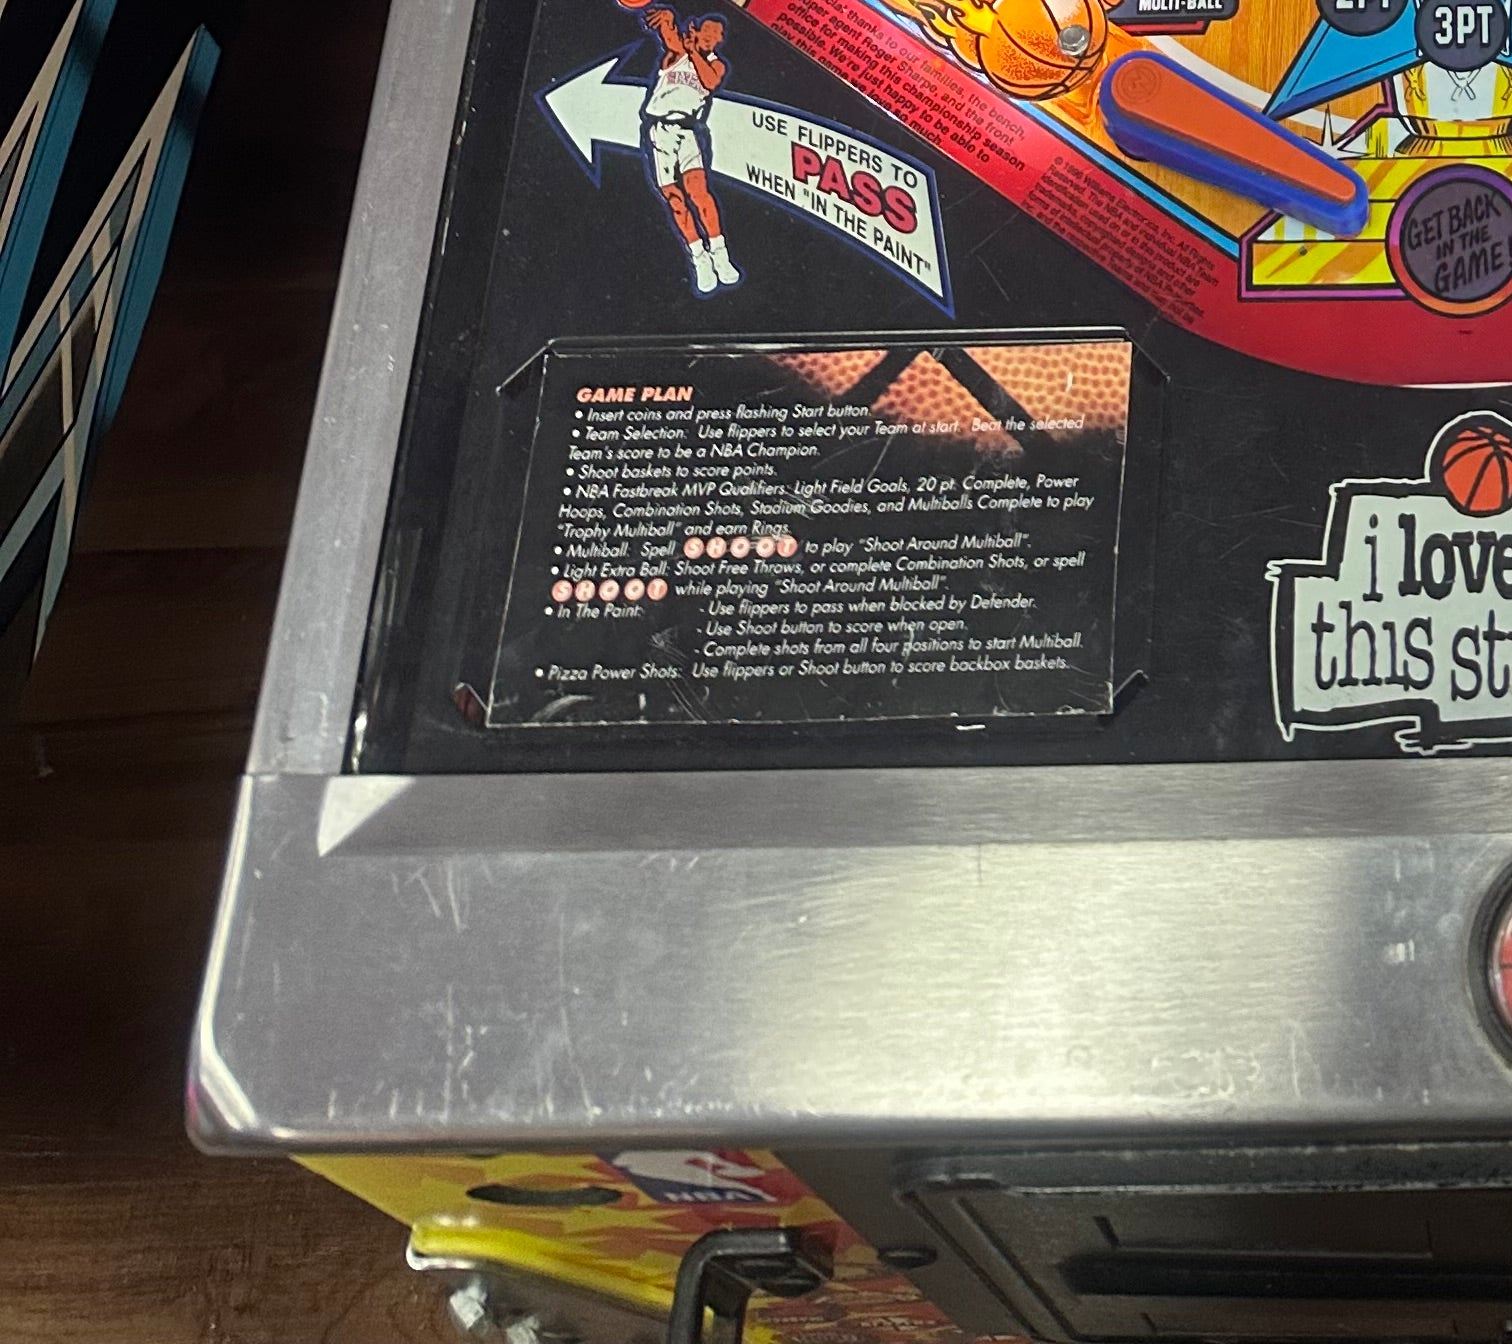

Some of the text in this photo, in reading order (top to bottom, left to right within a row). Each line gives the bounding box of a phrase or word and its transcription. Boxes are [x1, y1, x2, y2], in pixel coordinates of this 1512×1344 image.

[1435, 7, 1493, 45] 3PT
[752, 111, 919, 189] USE FLIPPERS TO
[791, 141, 918, 234] PASS
[746, 162, 932, 274] WHEN "IN THE PAINT"
[1407, 194, 1501, 251] GET BACK
[1436, 224, 1490, 260] IN THE
[577, 386, 693, 403] GAME PLAN
[587, 404, 823, 423] Insert coins and press flashing Start
[578, 463, 777, 480] Shoot baskets score points.
[1362, 513, 1383, 602] i
[1311, 600, 1435, 692] this
